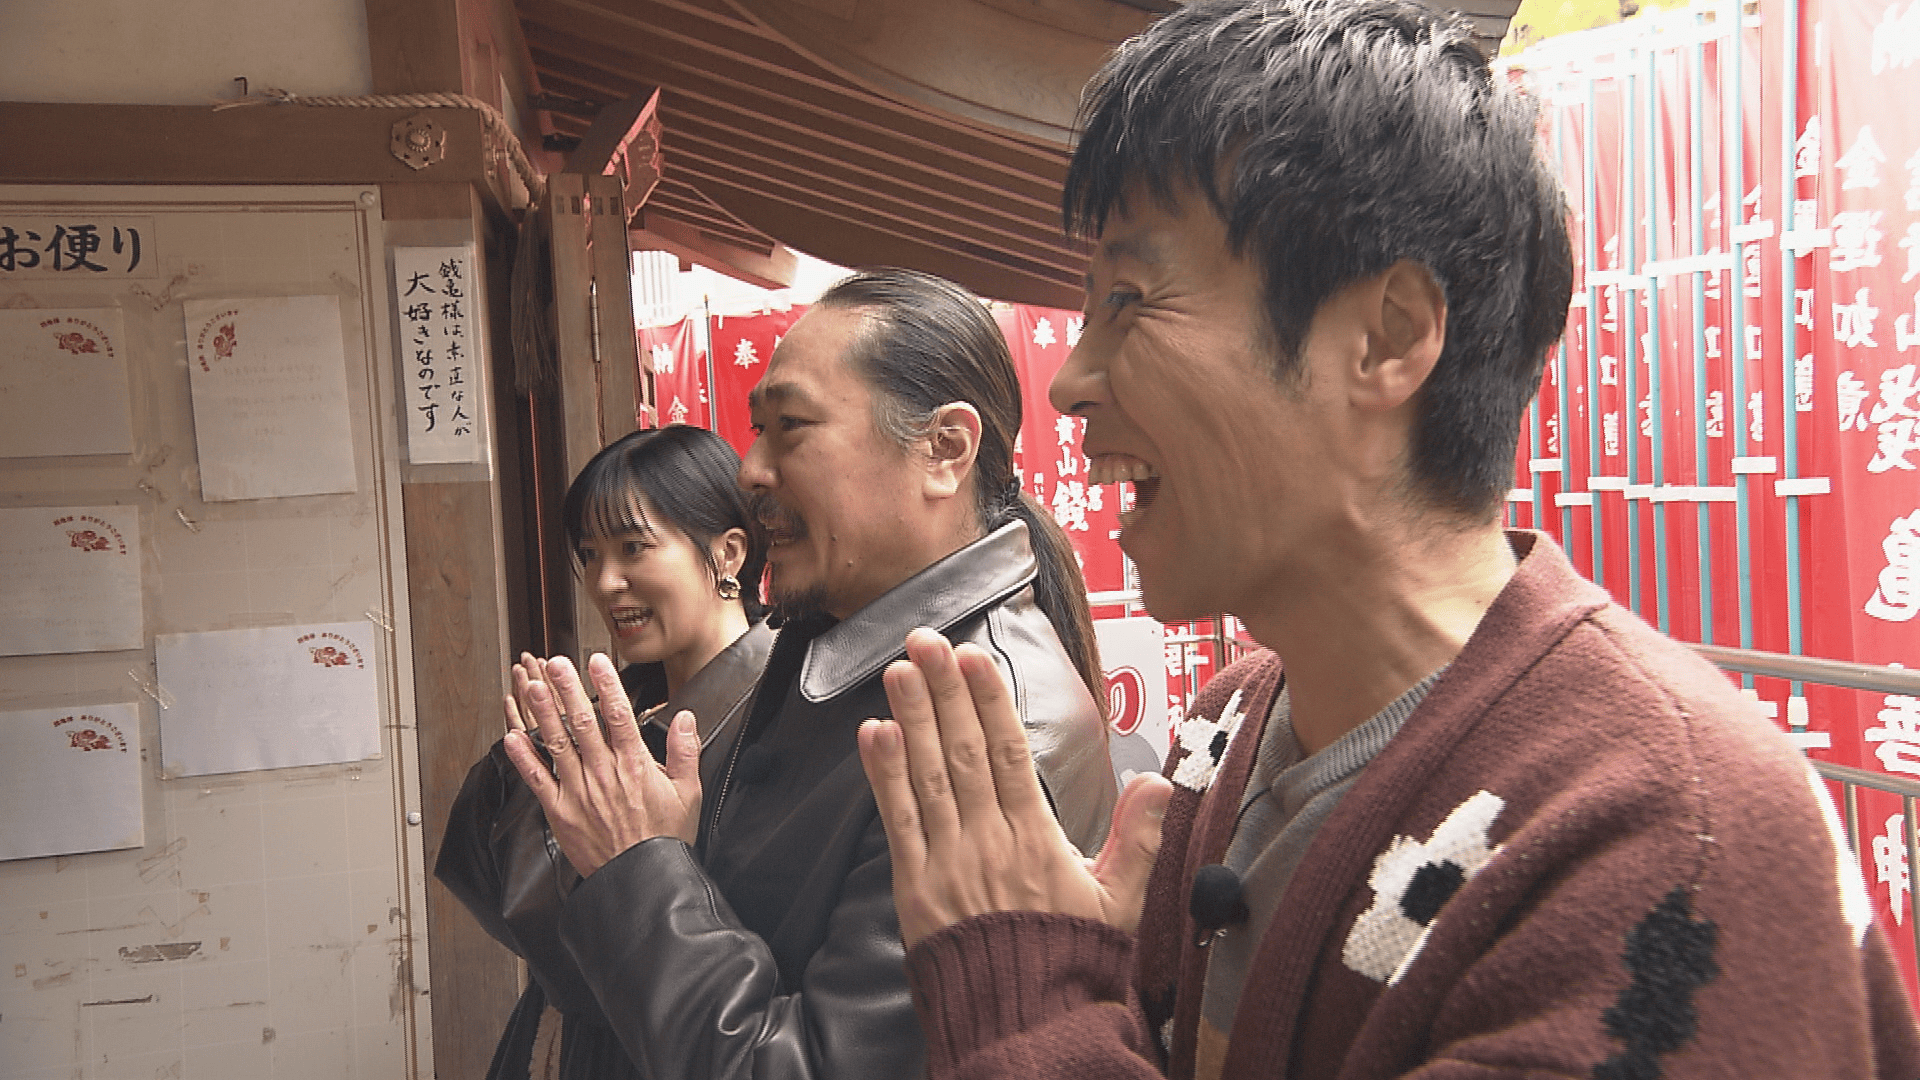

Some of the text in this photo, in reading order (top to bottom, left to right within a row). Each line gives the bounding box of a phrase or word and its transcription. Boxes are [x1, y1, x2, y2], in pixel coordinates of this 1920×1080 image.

[0, 224, 141, 273] お便り
[401, 271, 441, 433] 大好きなのです
